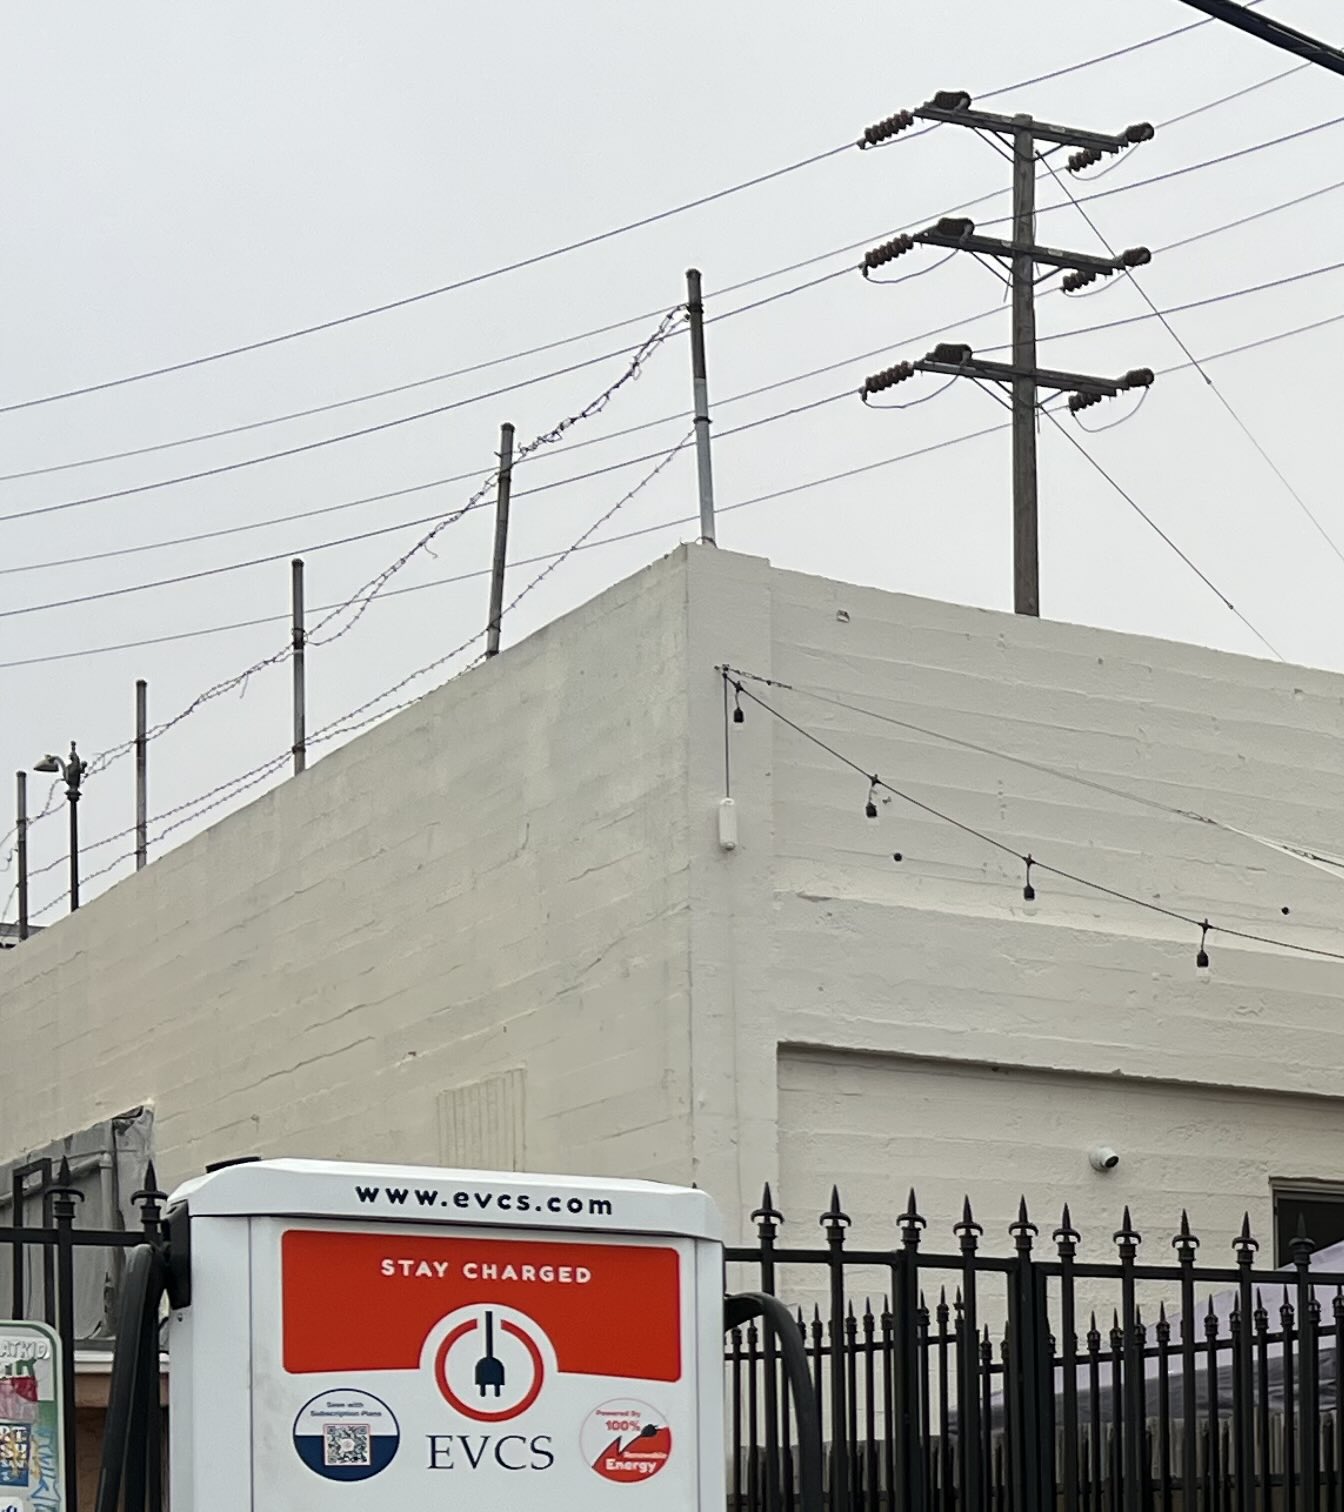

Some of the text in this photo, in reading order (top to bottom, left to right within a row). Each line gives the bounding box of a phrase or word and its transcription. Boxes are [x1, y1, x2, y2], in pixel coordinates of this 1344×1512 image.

[356, 1186, 612, 1215] www.evcs.com
[381, 1259, 592, 1283] STAY CHARGED
[606, 1421, 641, 1431] 100%
[427, 1434, 554, 1471] EVCS
[605, 1458, 657, 1473] Energy
